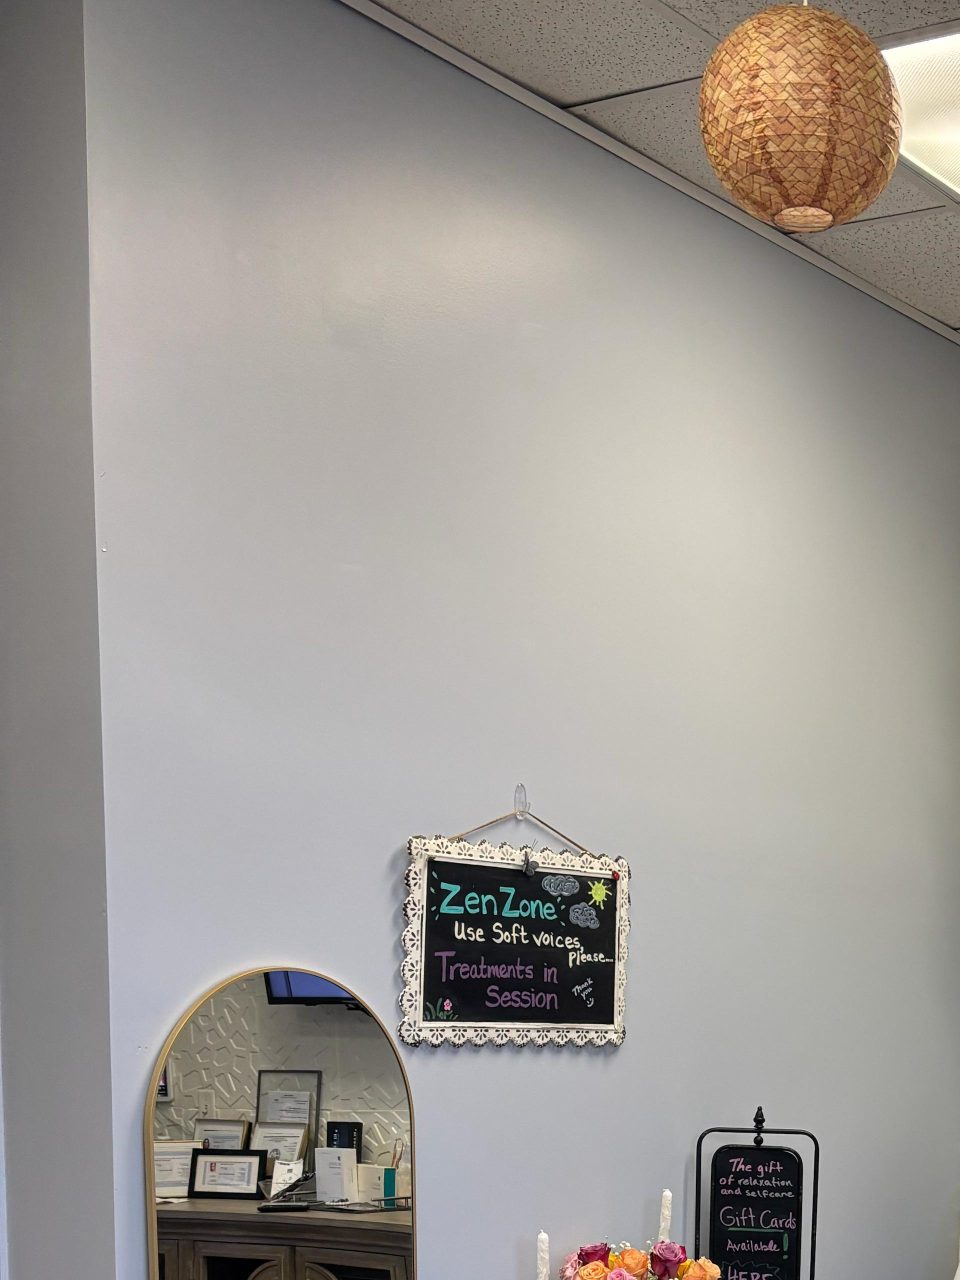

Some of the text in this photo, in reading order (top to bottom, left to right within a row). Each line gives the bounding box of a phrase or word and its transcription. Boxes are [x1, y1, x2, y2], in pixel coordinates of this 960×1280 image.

[440, 882, 558, 920] Zen Zone
[454, 921, 529, 944] Use Soft
[435, 951, 558, 984] Treatments in
[485, 985, 558, 1009] Session
[729, 1158, 783, 1177] The gift
[720, 1175, 793, 1187] of relaxation
[721, 1187, 742, 1195] and
[720, 1206, 796, 1230] Gift Cards
